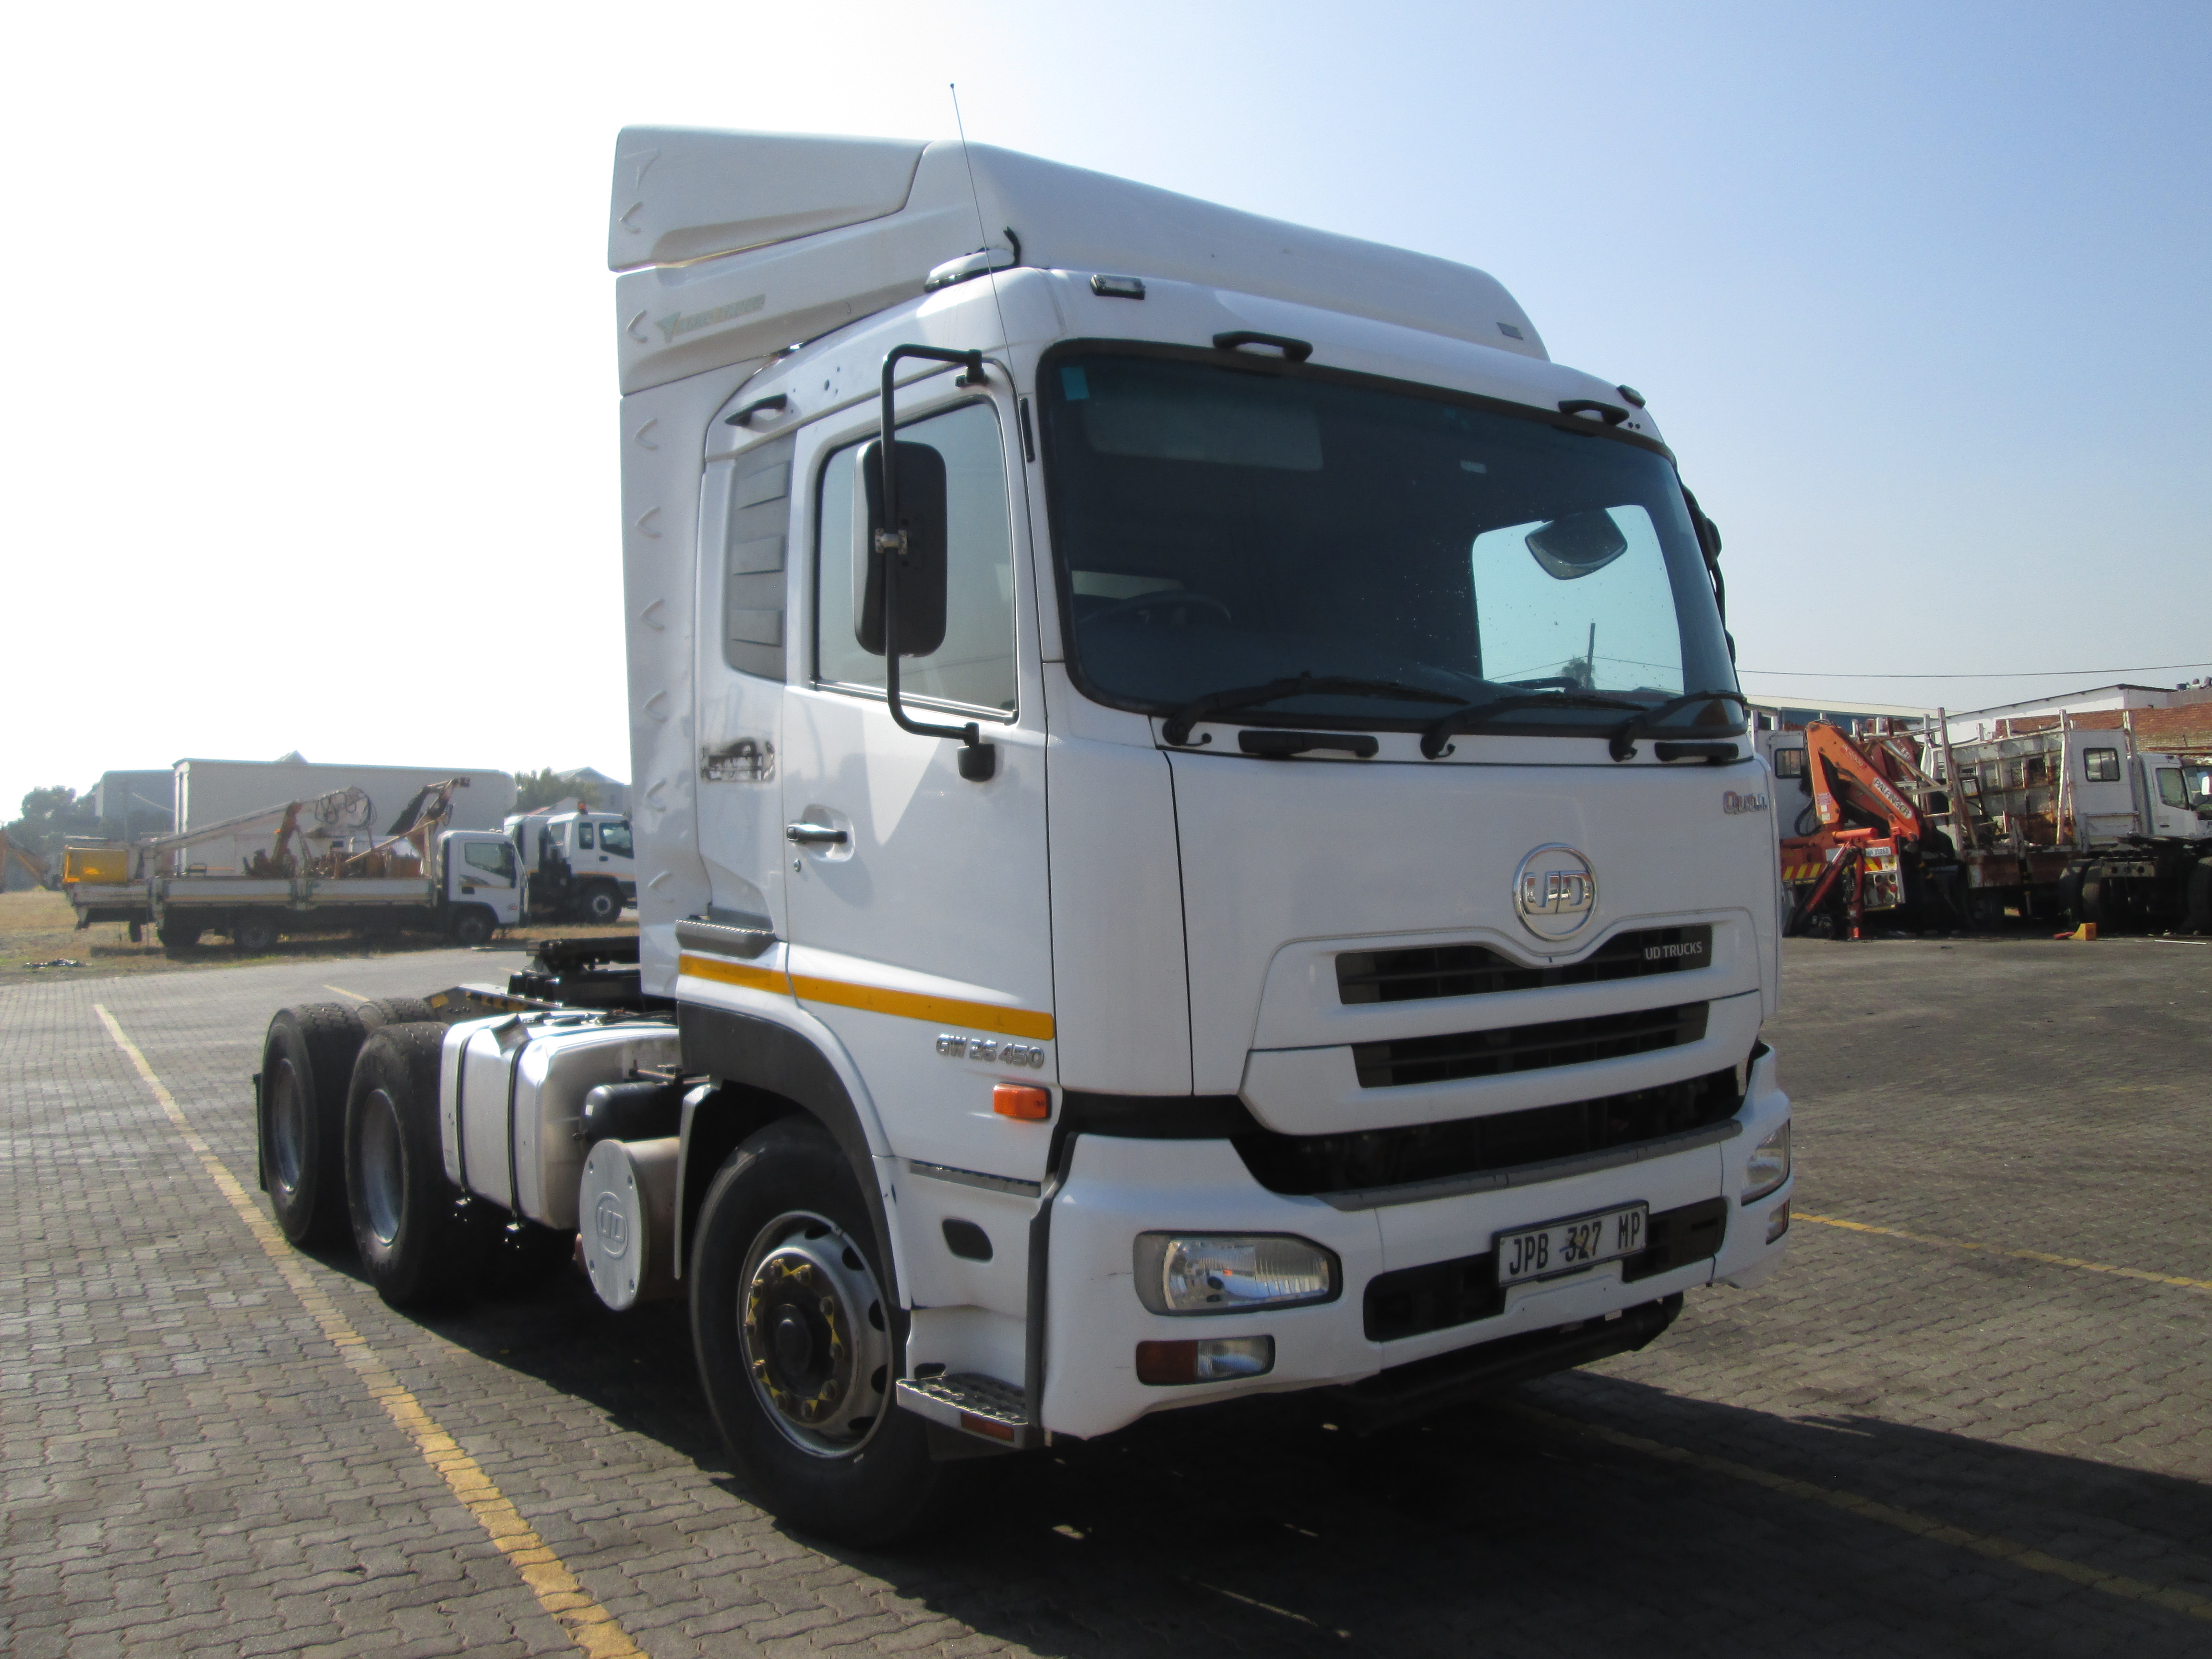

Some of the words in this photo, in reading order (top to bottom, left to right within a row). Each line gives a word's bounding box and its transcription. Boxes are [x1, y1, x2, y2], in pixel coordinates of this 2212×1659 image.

[1874, 779, 1910, 817] PALFINGER
[1521, 870, 1594, 915] UD
[1645, 947, 1660, 960] UD
[1662, 941, 1702, 958] TRUCKS
[937, 1034, 967, 1057] GW
[969, 1038, 997, 1062] 26
[998, 1043, 1045, 1069] 450
[1510, 1232, 1549, 1275] JPB
[1565, 1221, 1601, 1262] 327
[1618, 1211, 1640, 1249] MP
